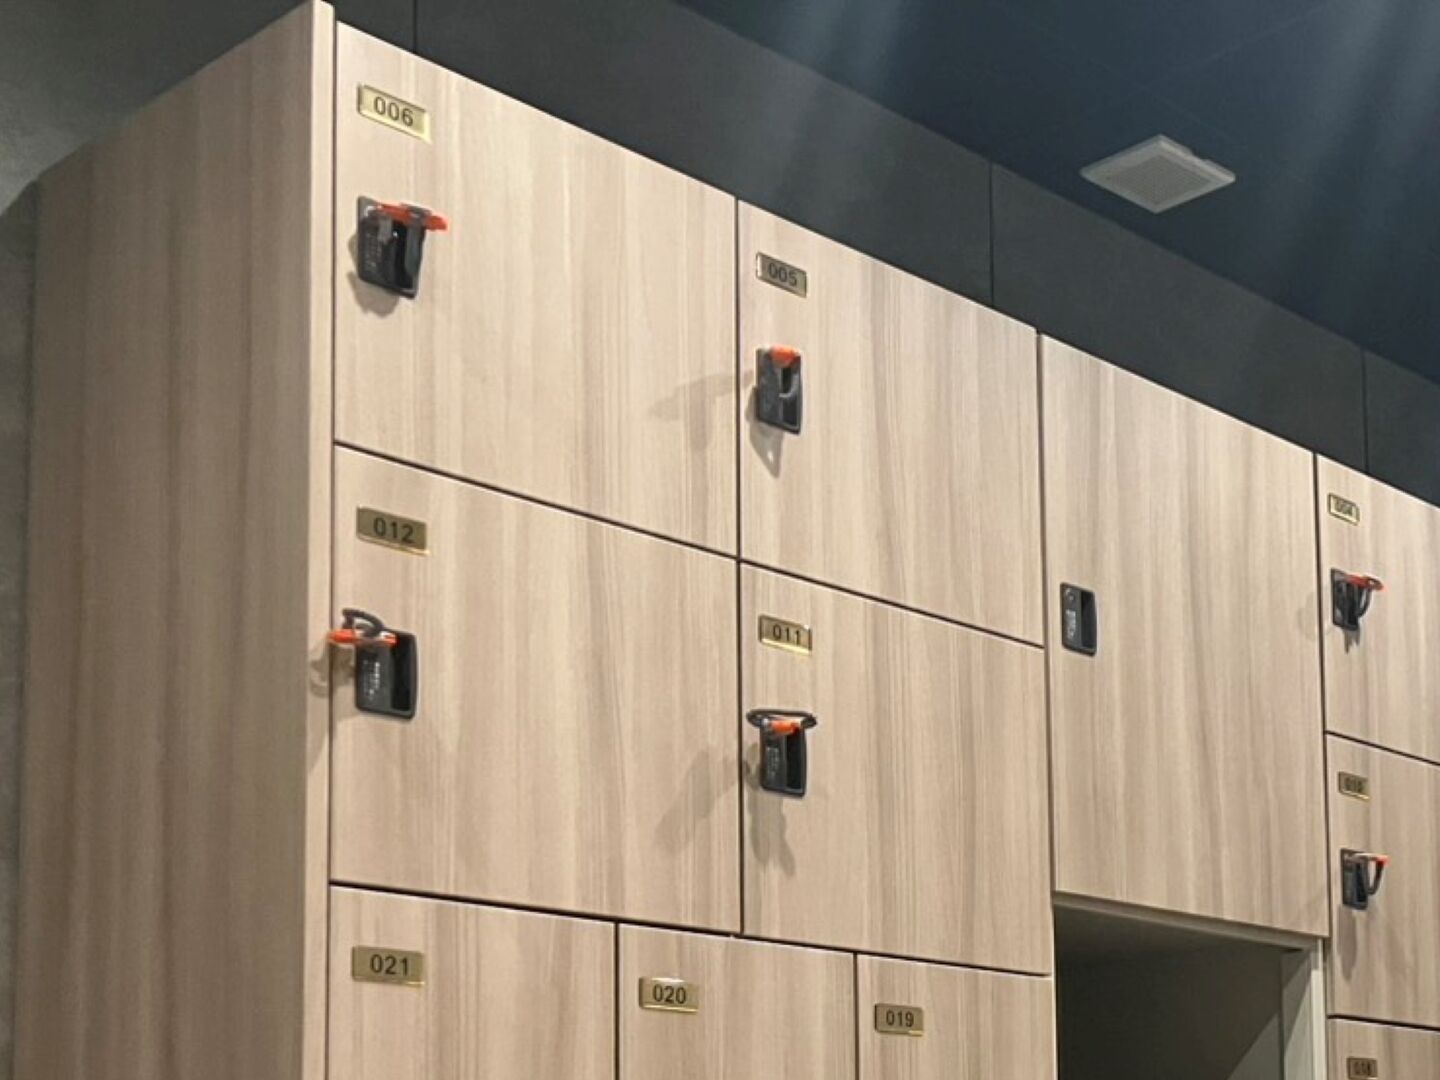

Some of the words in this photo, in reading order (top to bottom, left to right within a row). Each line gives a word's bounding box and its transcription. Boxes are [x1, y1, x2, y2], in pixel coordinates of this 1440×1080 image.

[373, 96, 414, 127] 006
[767, 262, 798, 287] 005
[373, 517, 415, 544] 012
[772, 624, 800, 646] 011
[369, 954, 409, 977] 021
[652, 983, 687, 1005] 020
[886, 1010, 914, 1028] 019
